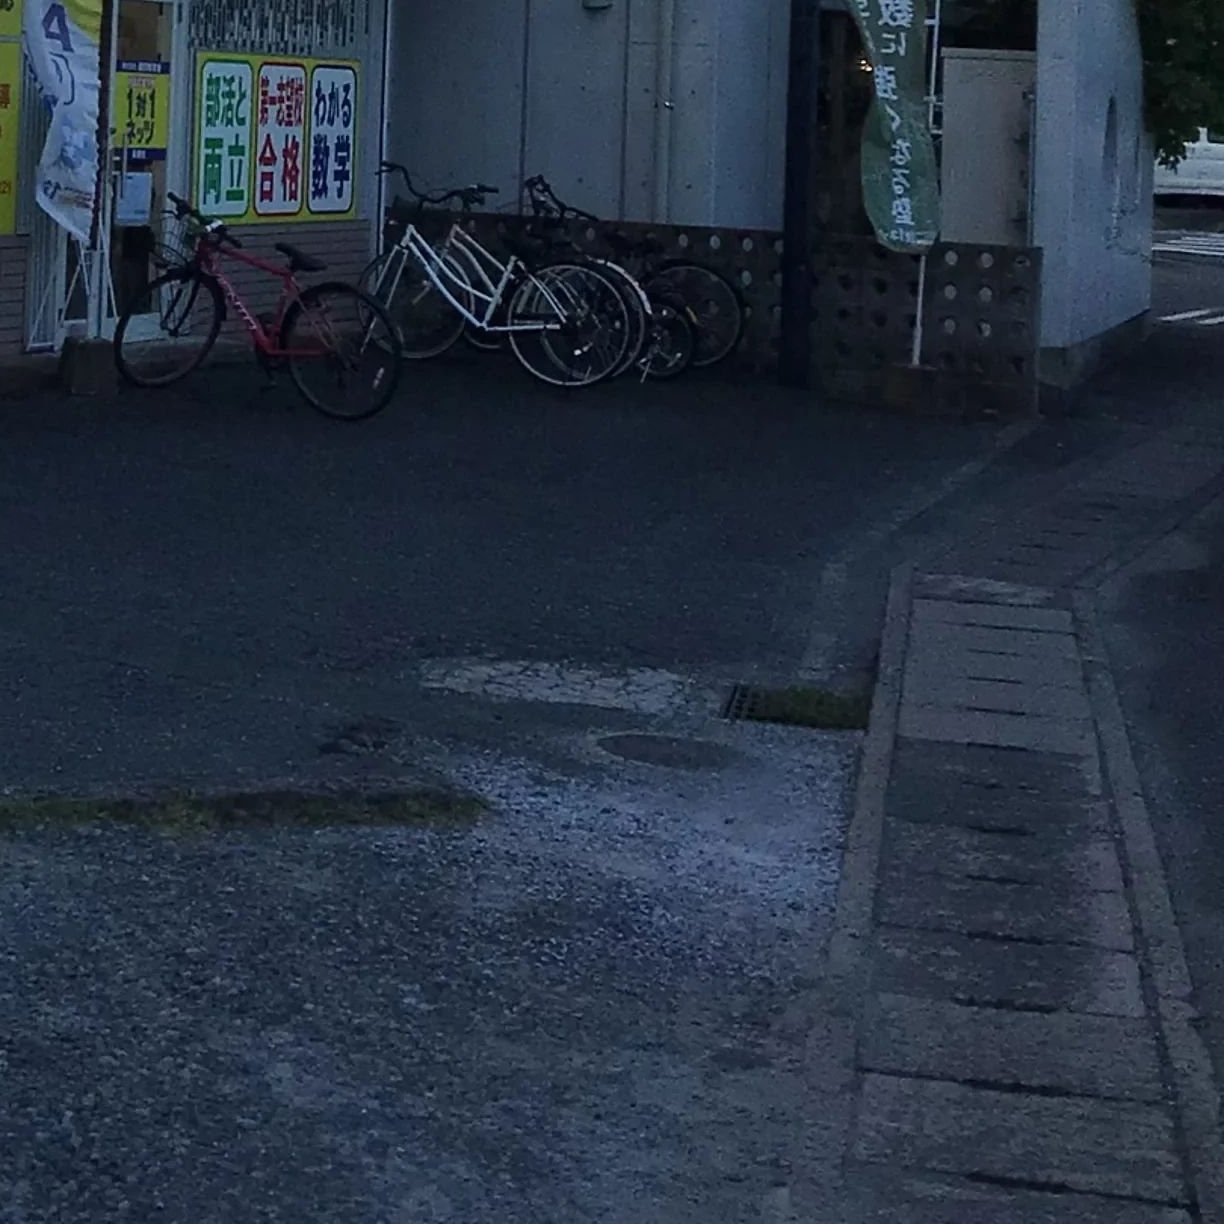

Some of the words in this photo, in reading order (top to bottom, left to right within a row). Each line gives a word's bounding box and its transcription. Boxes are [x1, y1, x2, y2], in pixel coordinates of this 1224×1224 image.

[205, 73, 247, 127] 部活と
[314, 79, 352, 128] わかる
[204, 133, 246, 205] 両立
[259, 133, 300, 203] 合格
[312, 133, 351, 200] 数学
